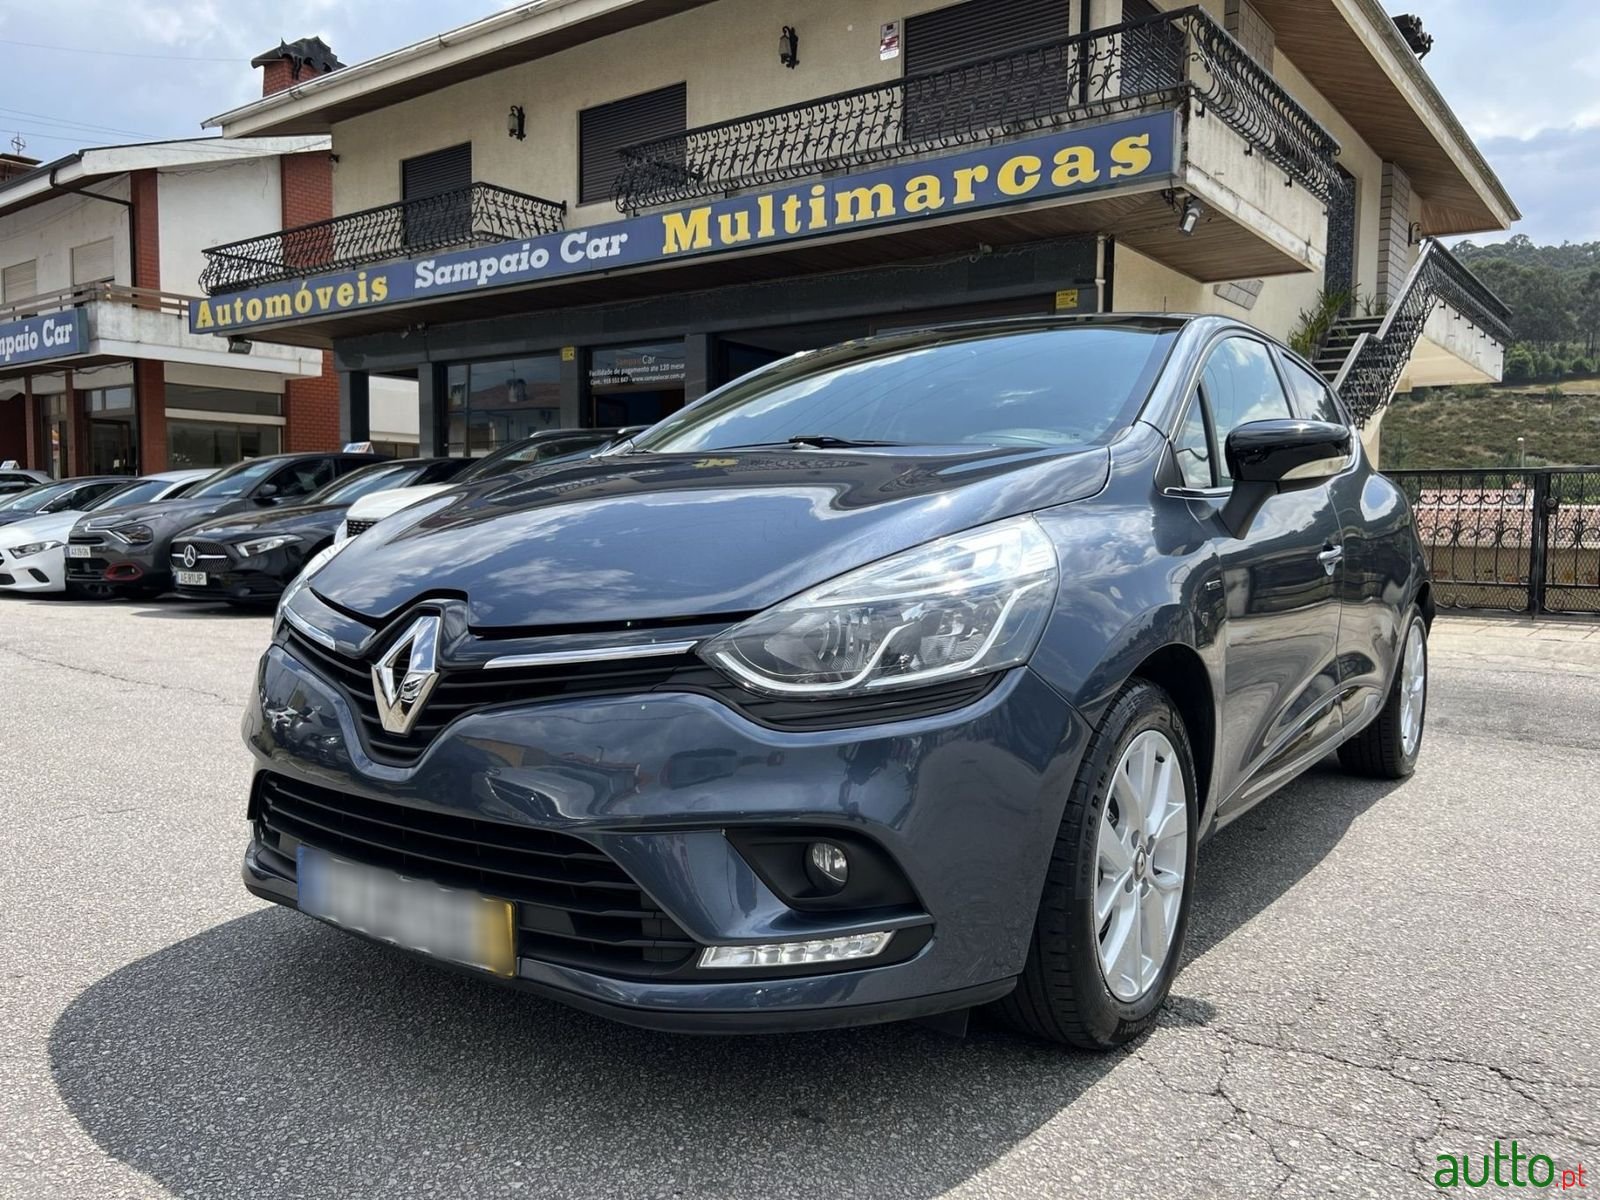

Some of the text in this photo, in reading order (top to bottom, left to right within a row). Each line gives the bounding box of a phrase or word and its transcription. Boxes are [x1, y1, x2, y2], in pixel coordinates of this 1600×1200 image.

[196, 133, 1153, 328] Automóveis Sampaio Car Multimarcas
[42, 318, 73, 348] Car
